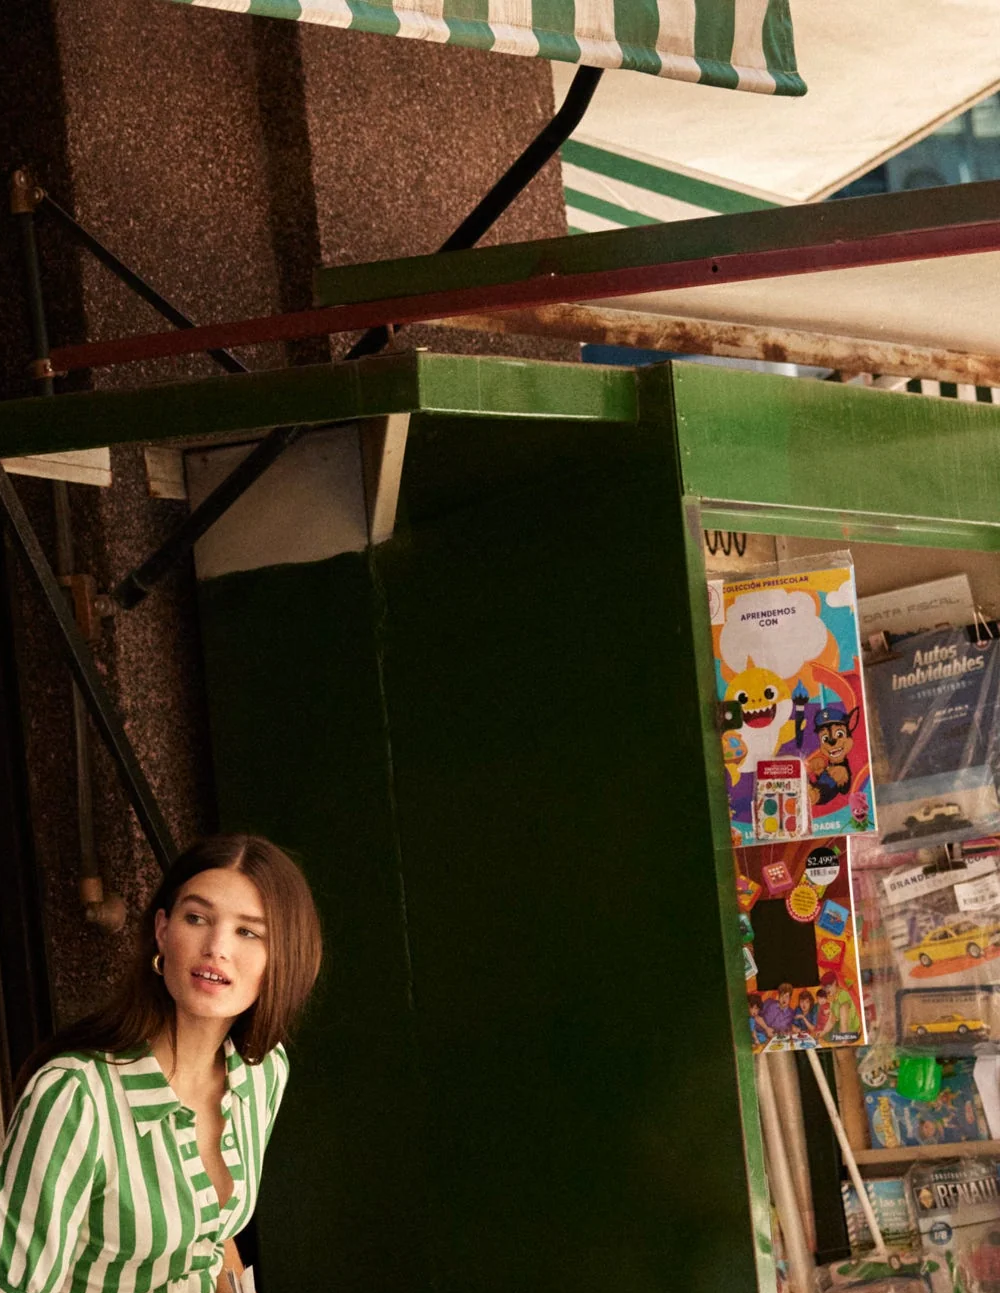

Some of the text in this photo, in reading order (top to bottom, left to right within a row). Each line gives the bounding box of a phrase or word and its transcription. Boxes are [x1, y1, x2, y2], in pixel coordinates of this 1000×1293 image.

[762, 575, 809, 588] PREESCOLAR
[740, 606, 796, 621] APRENDEMOS
[758, 618, 779, 628] CON
[912, 644, 957, 669] Autos
[891, 655, 985, 691] inolvidables
